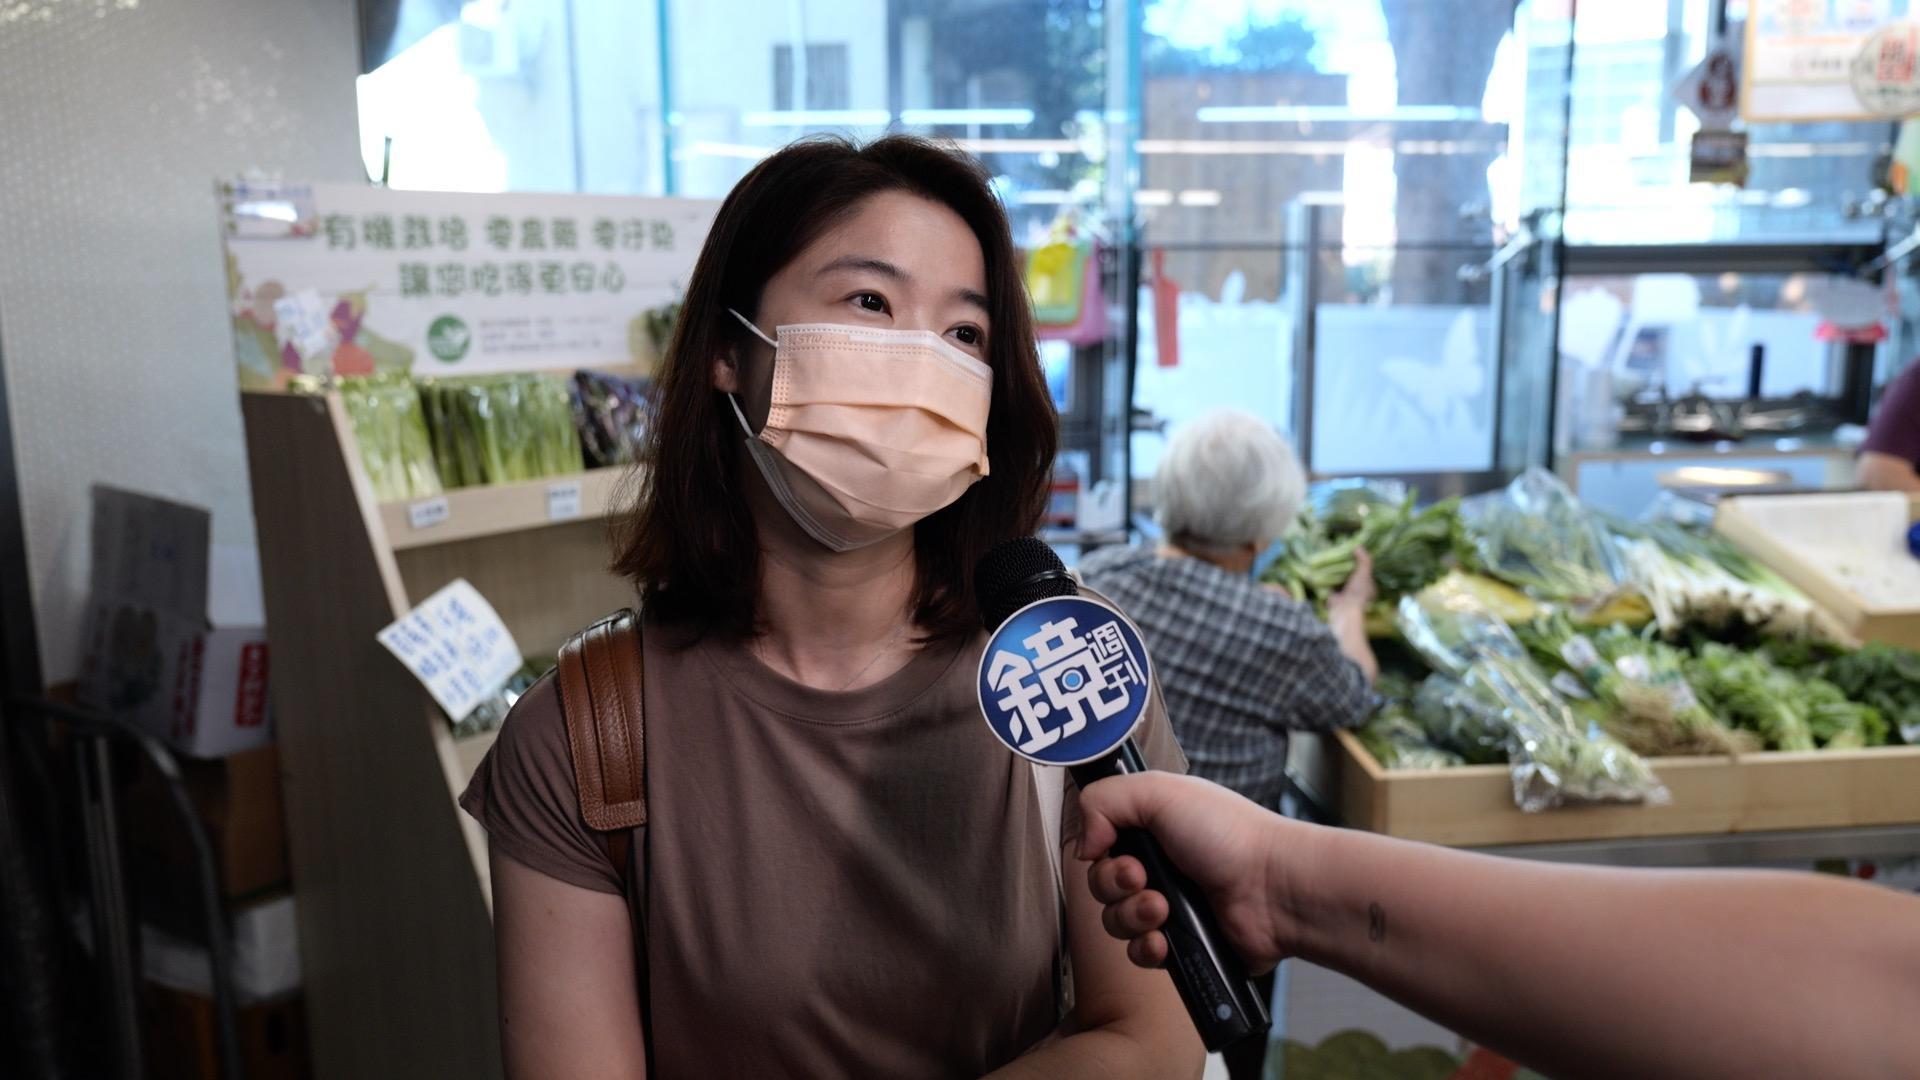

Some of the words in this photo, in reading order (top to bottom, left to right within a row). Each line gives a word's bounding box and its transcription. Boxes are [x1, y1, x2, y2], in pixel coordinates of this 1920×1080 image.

[399, 261, 626, 298] 讓您吃得更安心
[987, 617, 1147, 754] 鏡週刊
